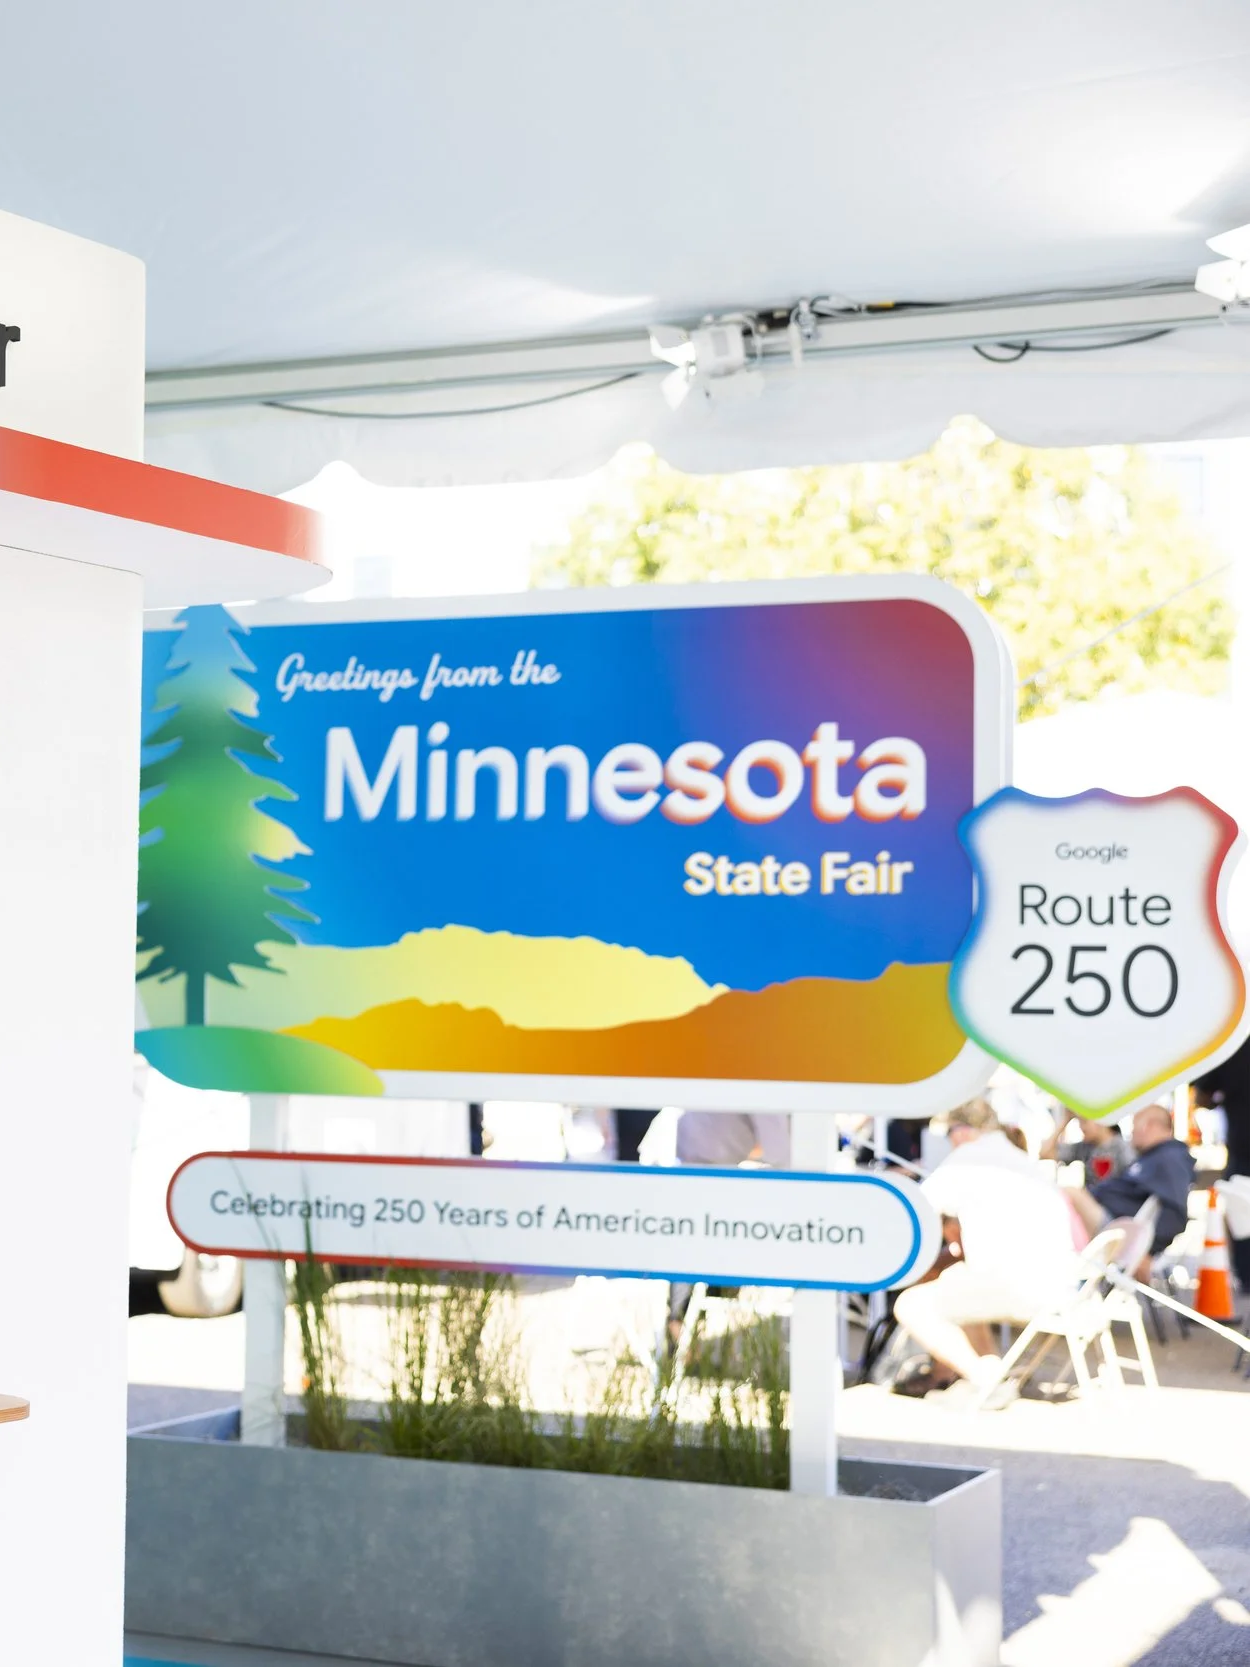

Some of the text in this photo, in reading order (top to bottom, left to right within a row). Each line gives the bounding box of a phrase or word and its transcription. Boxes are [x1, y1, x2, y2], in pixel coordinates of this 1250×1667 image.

[276, 649, 561, 702] Greetings from the
[323, 721, 929, 824] Minnesota
[683, 851, 914, 896] State Fair
[1055, 842, 1129, 863] Google
[1019, 884, 1172, 926] Route
[1010, 944, 1179, 1018] 250
[210, 1189, 864, 1245] Celebrating 250 Years of American Innovation
